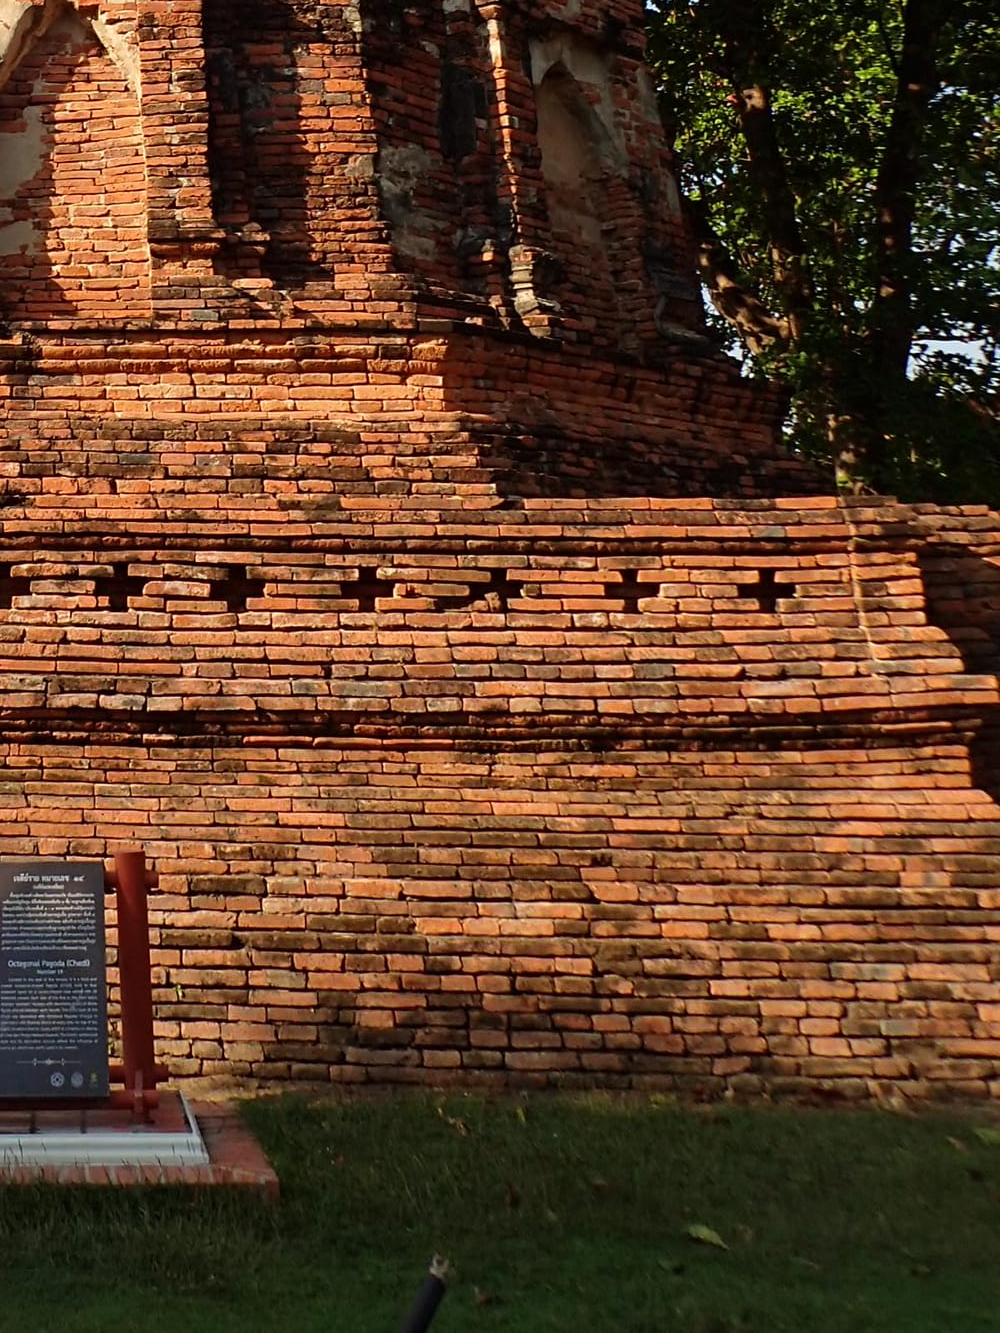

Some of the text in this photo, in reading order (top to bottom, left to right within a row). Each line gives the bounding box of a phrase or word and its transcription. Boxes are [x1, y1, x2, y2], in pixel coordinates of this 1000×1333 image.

[8, 958, 90, 969] Octagonal Pagoda (Chedi)
